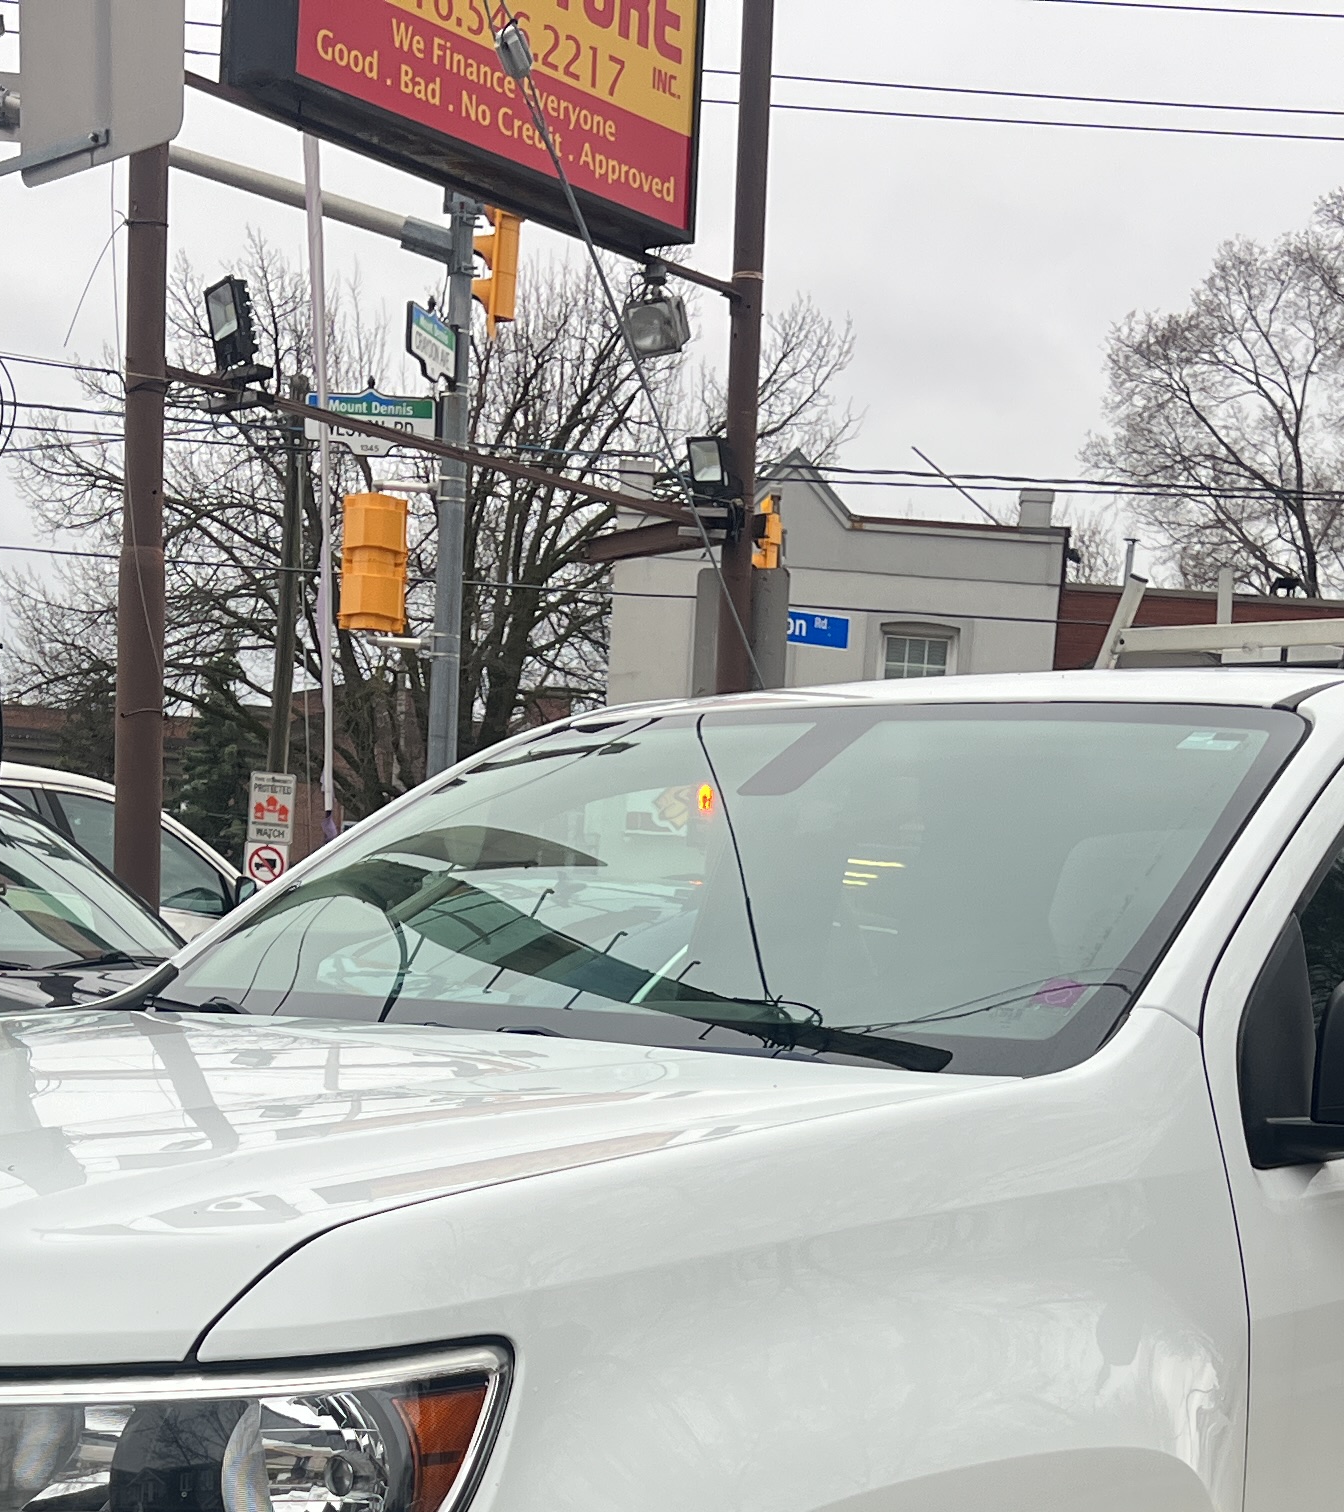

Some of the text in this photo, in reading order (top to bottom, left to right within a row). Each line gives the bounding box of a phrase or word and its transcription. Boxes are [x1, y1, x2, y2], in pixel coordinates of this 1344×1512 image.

[391, 18, 617, 141] We Finance Everyone
[652, 66, 681, 99] INC.
[316, 28, 379, 80] Good
[400, 63, 440, 106] Bad
[461, 89, 491, 126] No
[497, 107, 563, 157] Credit
[579, 142, 675, 203] Approved
[328, 399, 414, 416] Mount Dennis
[256, 828, 285, 839] WATCH
